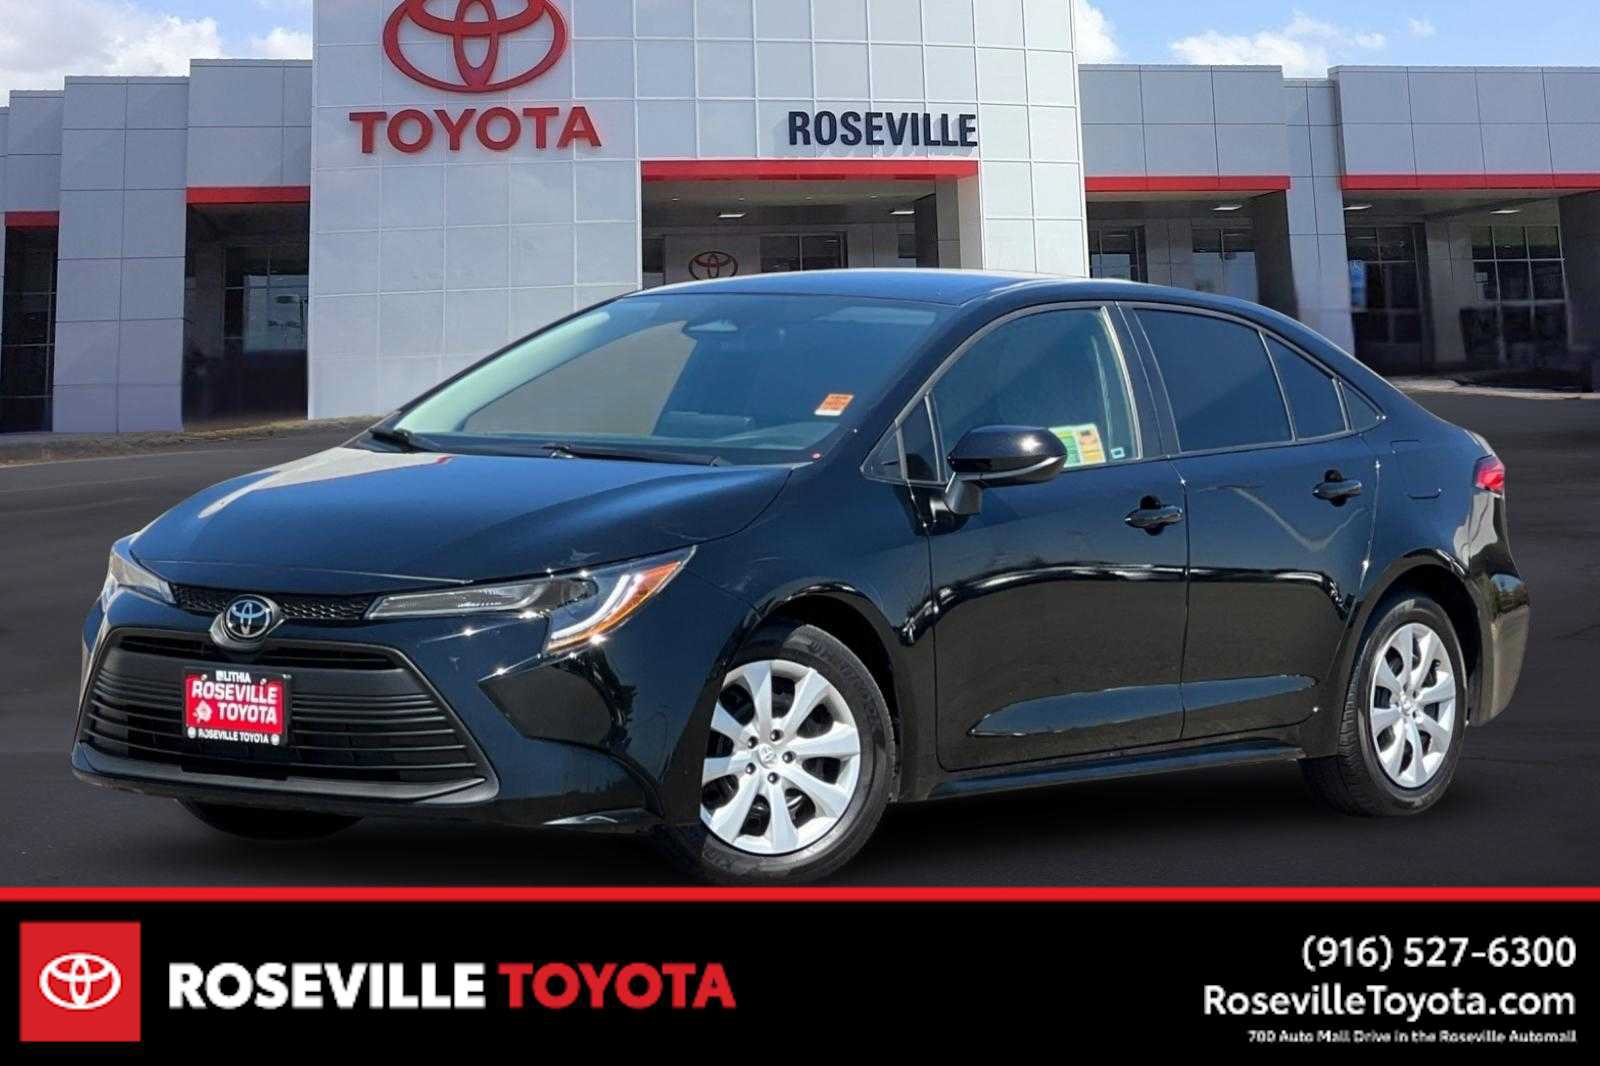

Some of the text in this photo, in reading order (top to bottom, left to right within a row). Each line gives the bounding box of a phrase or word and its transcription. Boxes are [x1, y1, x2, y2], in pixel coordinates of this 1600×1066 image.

[349, 105, 603, 154] TOYOTA
[788, 111, 979, 148] ROSEVILLE
[223, 670, 251, 683] LITHIA
[191, 680, 278, 705] ROSEVILLE
[217, 702, 278, 725] TOYOTA
[198, 728, 270, 744] ROSEVILLE TOYOTA
